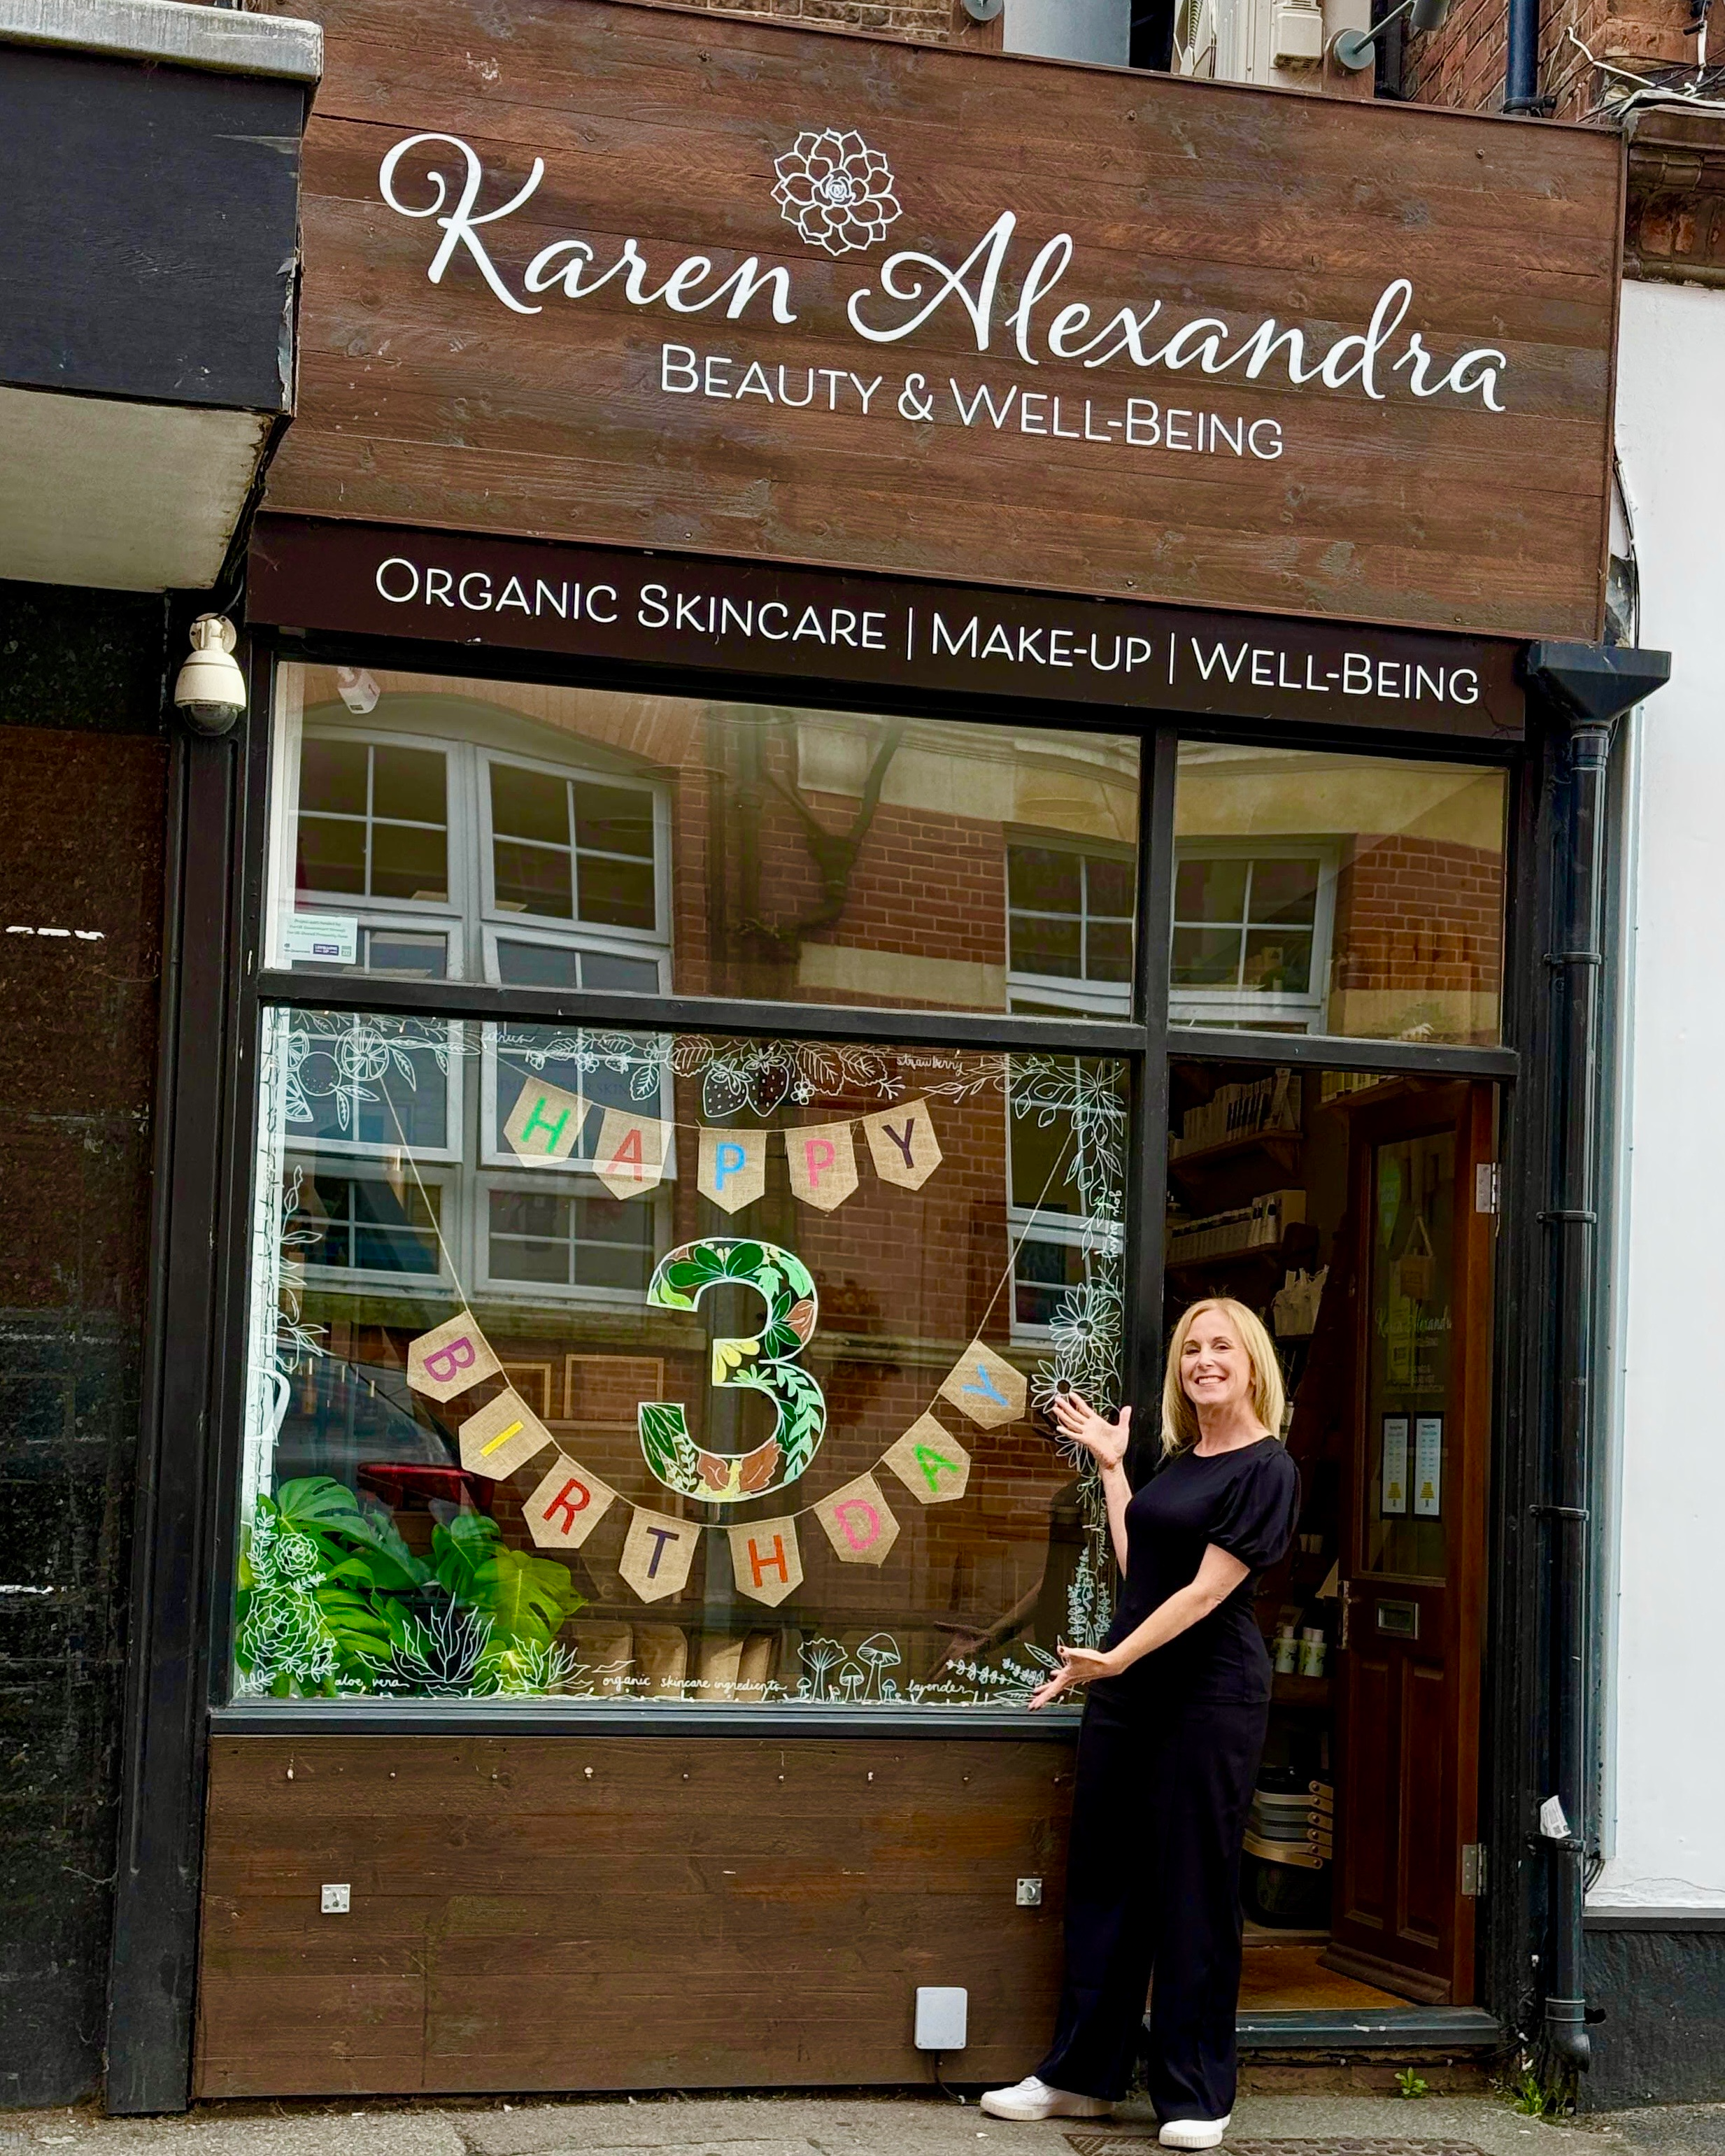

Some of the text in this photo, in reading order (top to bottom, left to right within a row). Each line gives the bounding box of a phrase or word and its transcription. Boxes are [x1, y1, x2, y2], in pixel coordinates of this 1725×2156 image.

[378, 132, 1507, 413] Karen Alexandra
[660, 343, 1284, 460] BEAUTY & WELL-BEING
[375, 558, 618, 623] ORGANIC
[637, 583, 887, 650] SKINCARE
[1191, 637, 1479, 705] WELL-BEING
[896, 1053, 968, 1077] strawberry
[637, 1236, 827, 1503] 3
[602, 1675, 788, 1694] organic skincare ingredients
